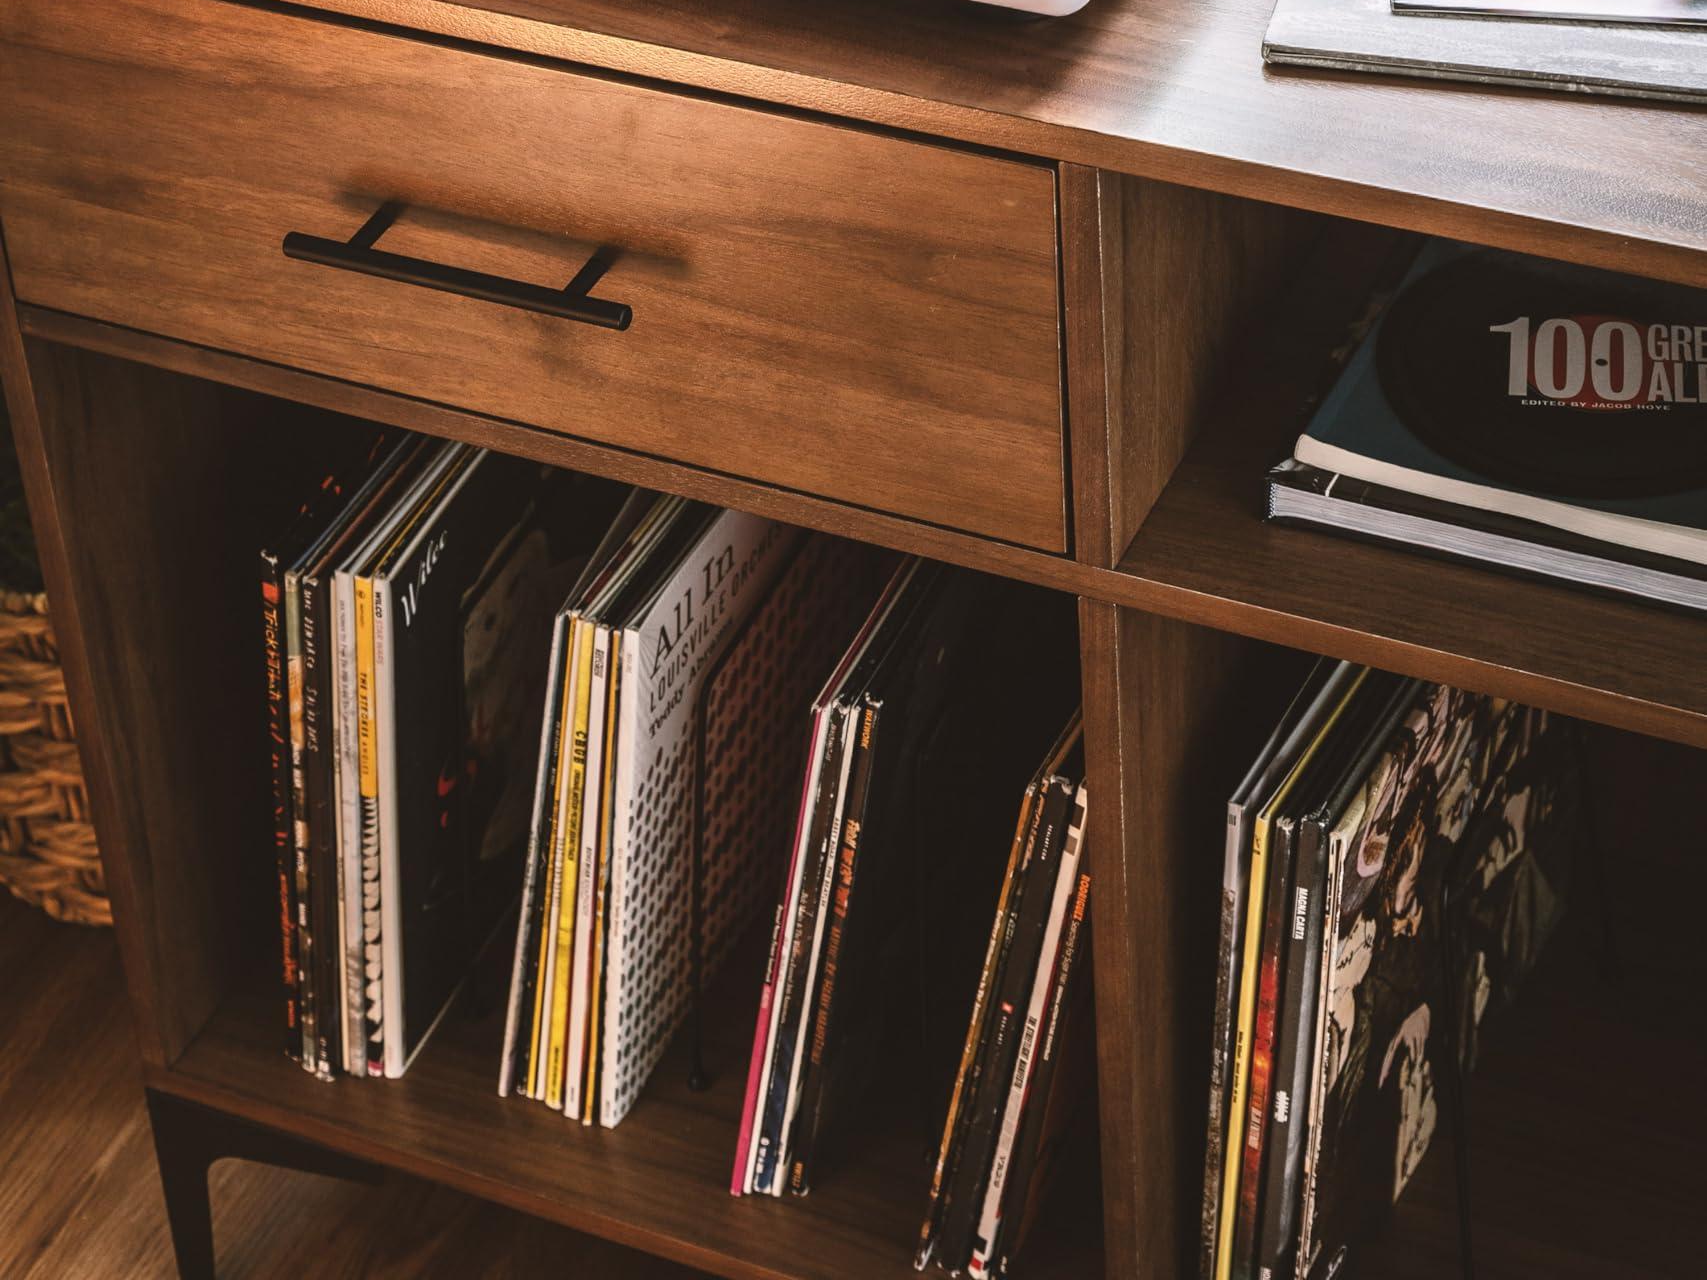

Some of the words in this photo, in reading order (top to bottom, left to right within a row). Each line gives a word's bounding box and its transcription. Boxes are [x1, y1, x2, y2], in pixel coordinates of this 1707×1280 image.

[1489, 316, 1643, 401] 100
[1521, 399, 1566, 407] EDITED
[1637, 404, 1671, 412] HOYE
[650, 587, 695, 680] All
[702, 543, 735, 607] In
[650, 589, 727, 714] LOUISVILLE
[359, 672, 367, 690] THE
[360, 694, 368, 737] STROKES
[860, 708, 872, 748] WAXWORK
[571, 730, 588, 765] CBGB
[1071, 873, 1092, 921] RODRIGUEZ
[1296, 887, 1308, 915] MAGNA
[1294, 915, 1305, 939] CARTA
